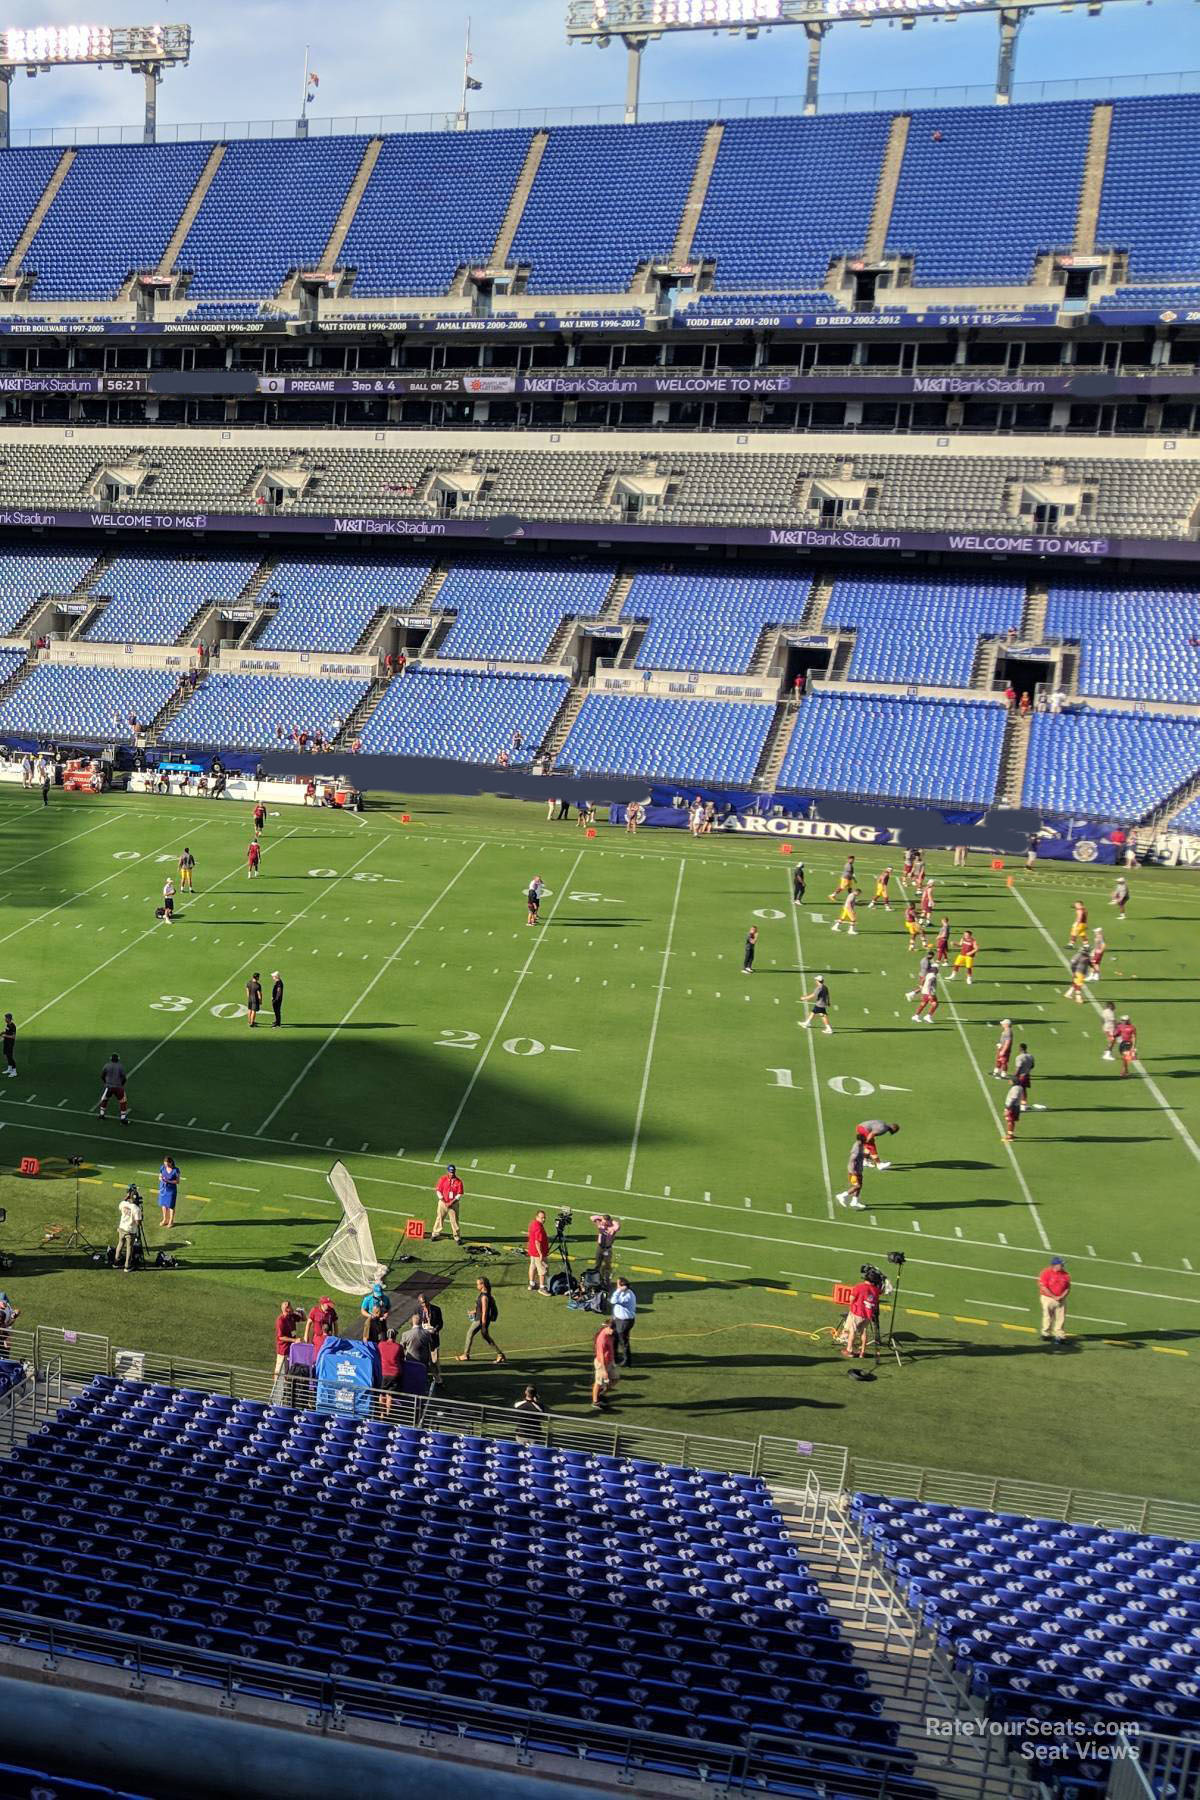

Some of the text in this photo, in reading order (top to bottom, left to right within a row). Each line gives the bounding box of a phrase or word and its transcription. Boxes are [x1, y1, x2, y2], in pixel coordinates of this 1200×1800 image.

[318, 322, 407, 331] MATT STOVER 1996-2008
[435, 321, 528, 330] JAMAL LEWIS 2000-2006
[559, 319, 641, 328] RAY LEWIS 1996-2012
[686, 317, 780, 326] TODD HEAP 2001-2010
[816, 316, 900, 325] ED REED 2002-2012
[11, 325, 105, 333] PETER BOULWARE 1997-2005
[227, 324, 264, 332] 1996-2007
[24, 379, 49, 391] Bank
[50, 379, 92, 392] Stadium
[107, 380, 141, 391] 56:21
[268, 380, 278, 392] 0
[291, 380, 335, 392] PREGAME
[351, 380, 396, 391] 3RD & 4
[409, 380, 460, 391] BALL ON 25
[523, 379, 637, 392] M&T Bank Stadium
[655, 379, 750, 391] WELCOME TO
[913, 378, 1045, 393] M&T Bank Stadium
[13, 512, 55, 525] Stadium
[91, 515, 172, 527] WELCOME TO
[334, 519, 445, 534] M&T Bank Stadium
[769, 530, 900, 548] M&T Bank Stadium
[949, 537, 1061, 552] WELCOME TO
[148, 994, 247, 1020] 30
[433, 1028, 546, 1057] 20
[765, 1066, 877, 1098] 10
[22, 1160, 35, 1172] 30
[408, 1221, 423, 1237] 20
[836, 1286, 851, 1304] 10
